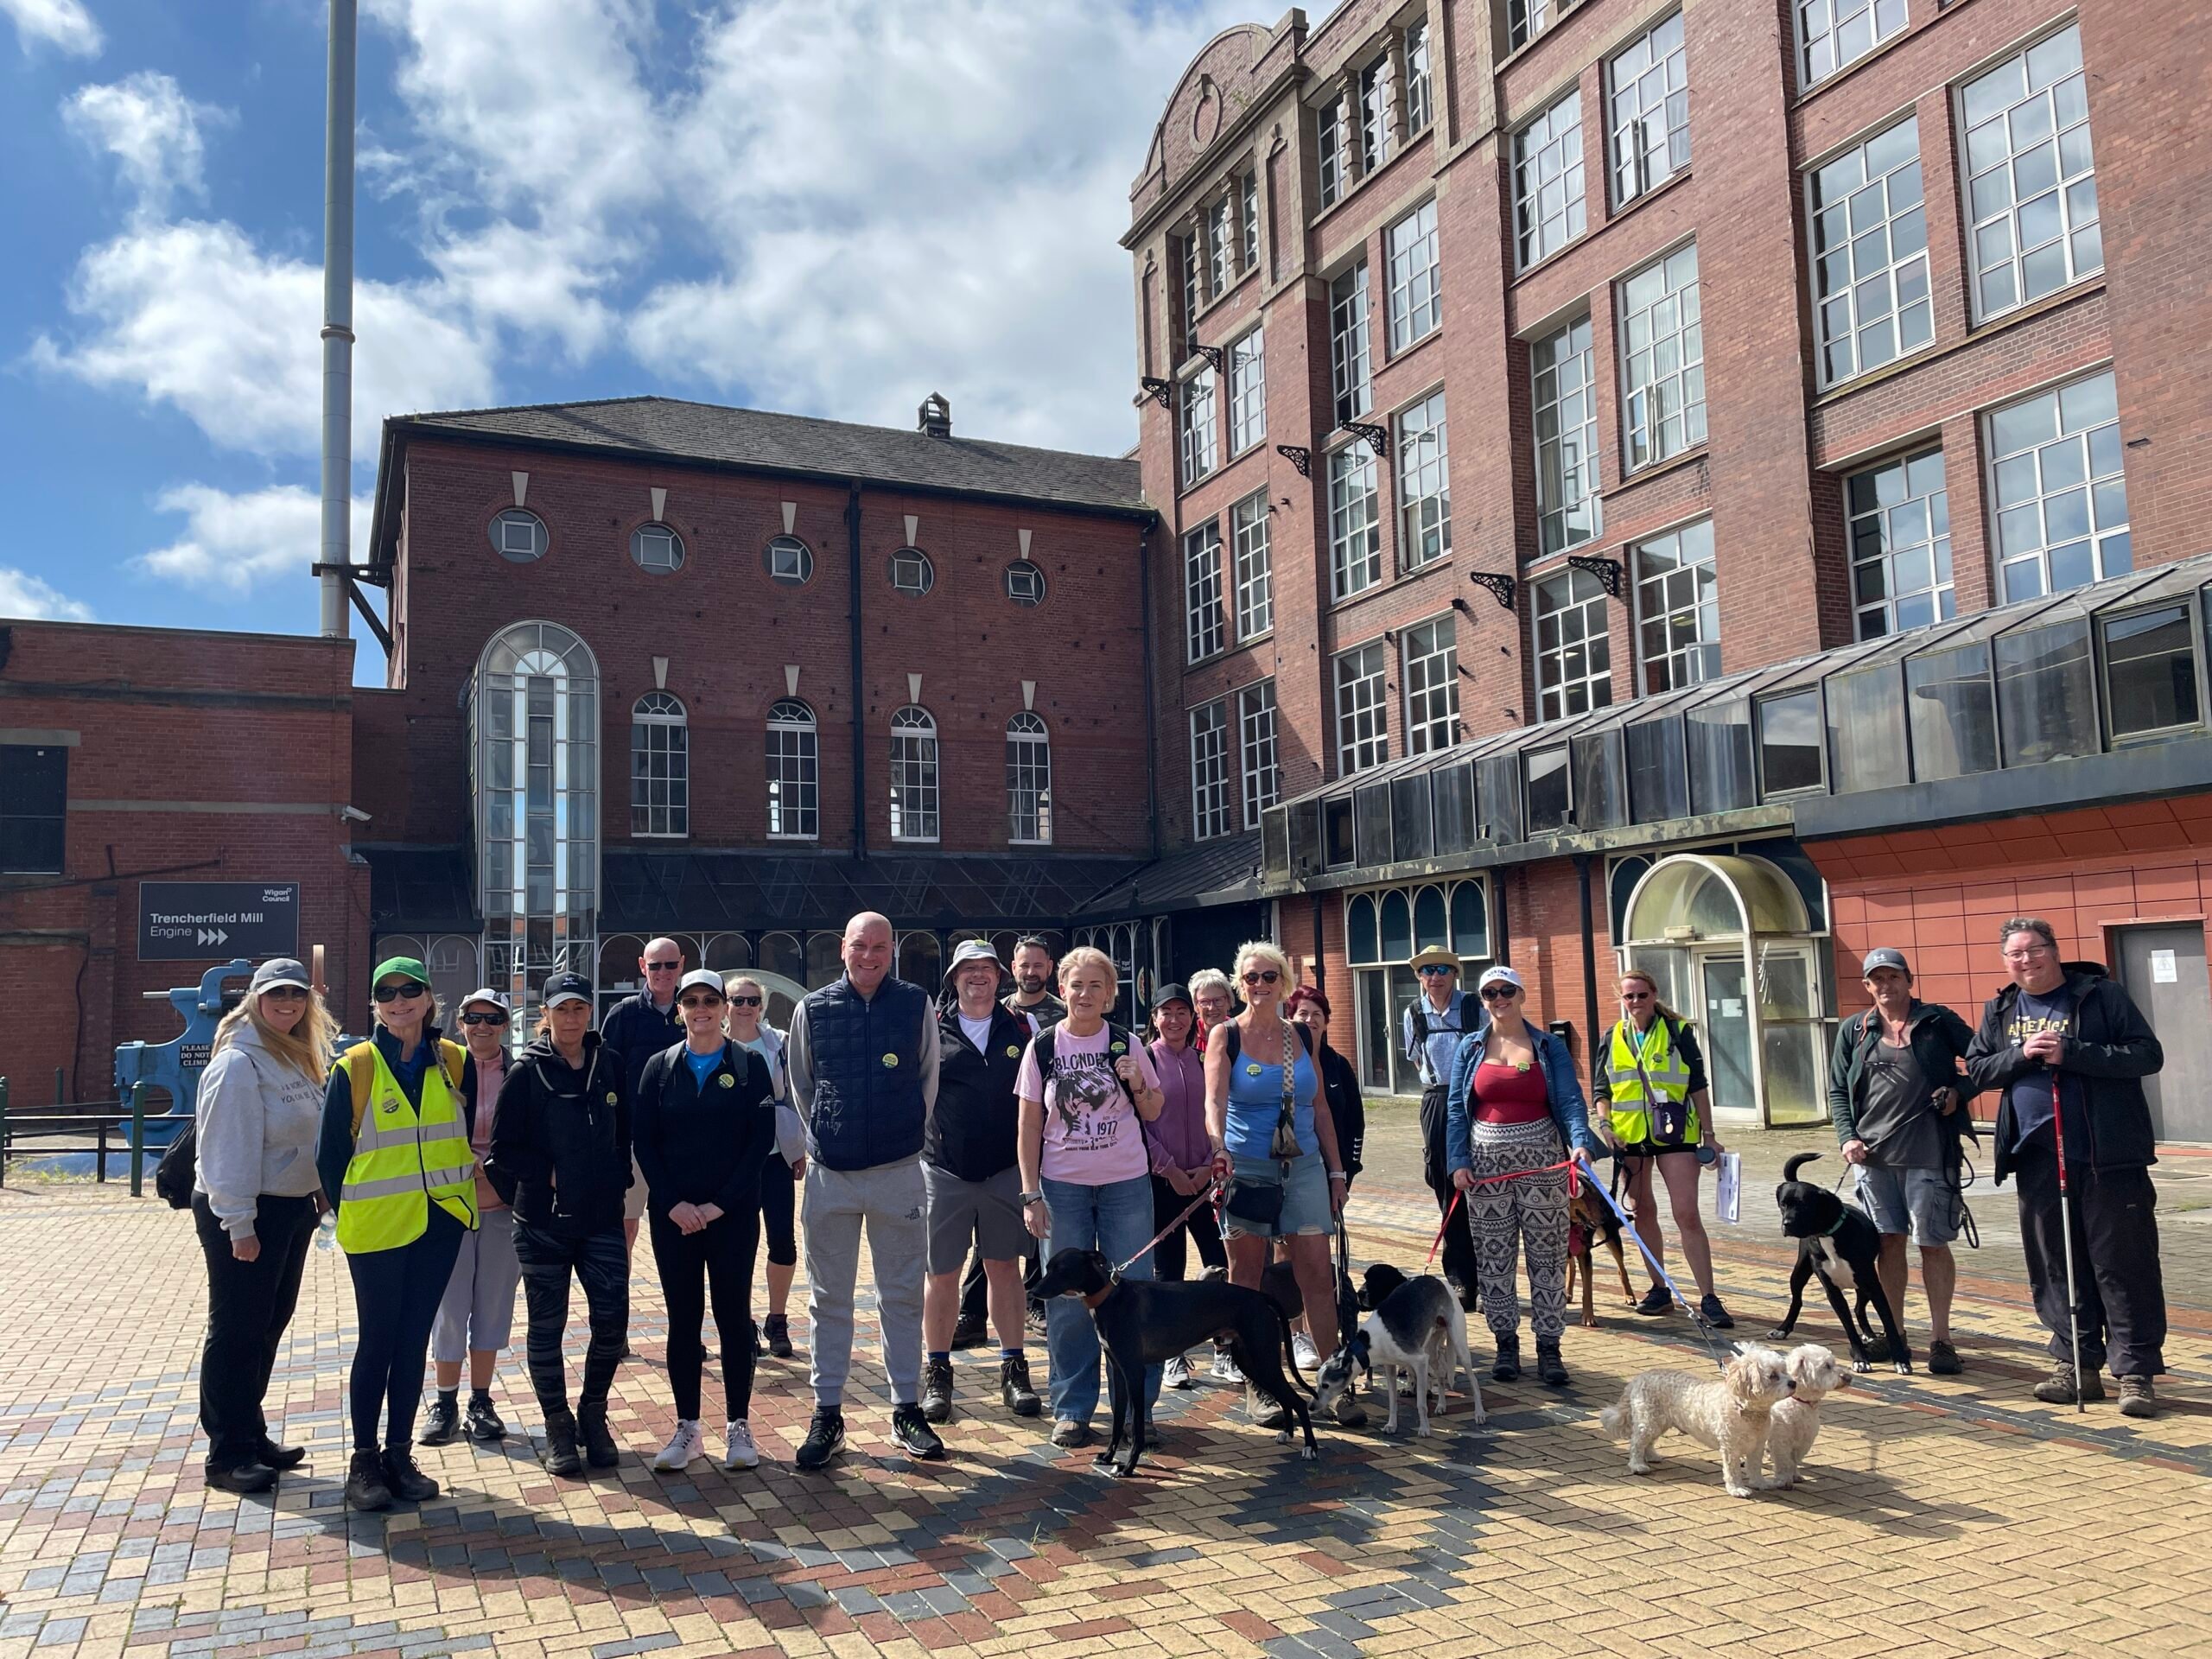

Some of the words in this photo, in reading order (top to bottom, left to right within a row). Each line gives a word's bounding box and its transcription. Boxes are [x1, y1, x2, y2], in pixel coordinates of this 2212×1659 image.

[149, 912, 237, 923] Trencherfield
[240, 912, 264, 923] Mill
[150, 926, 192, 938] Engine
[1097, 1121, 1118, 1135] 1977
